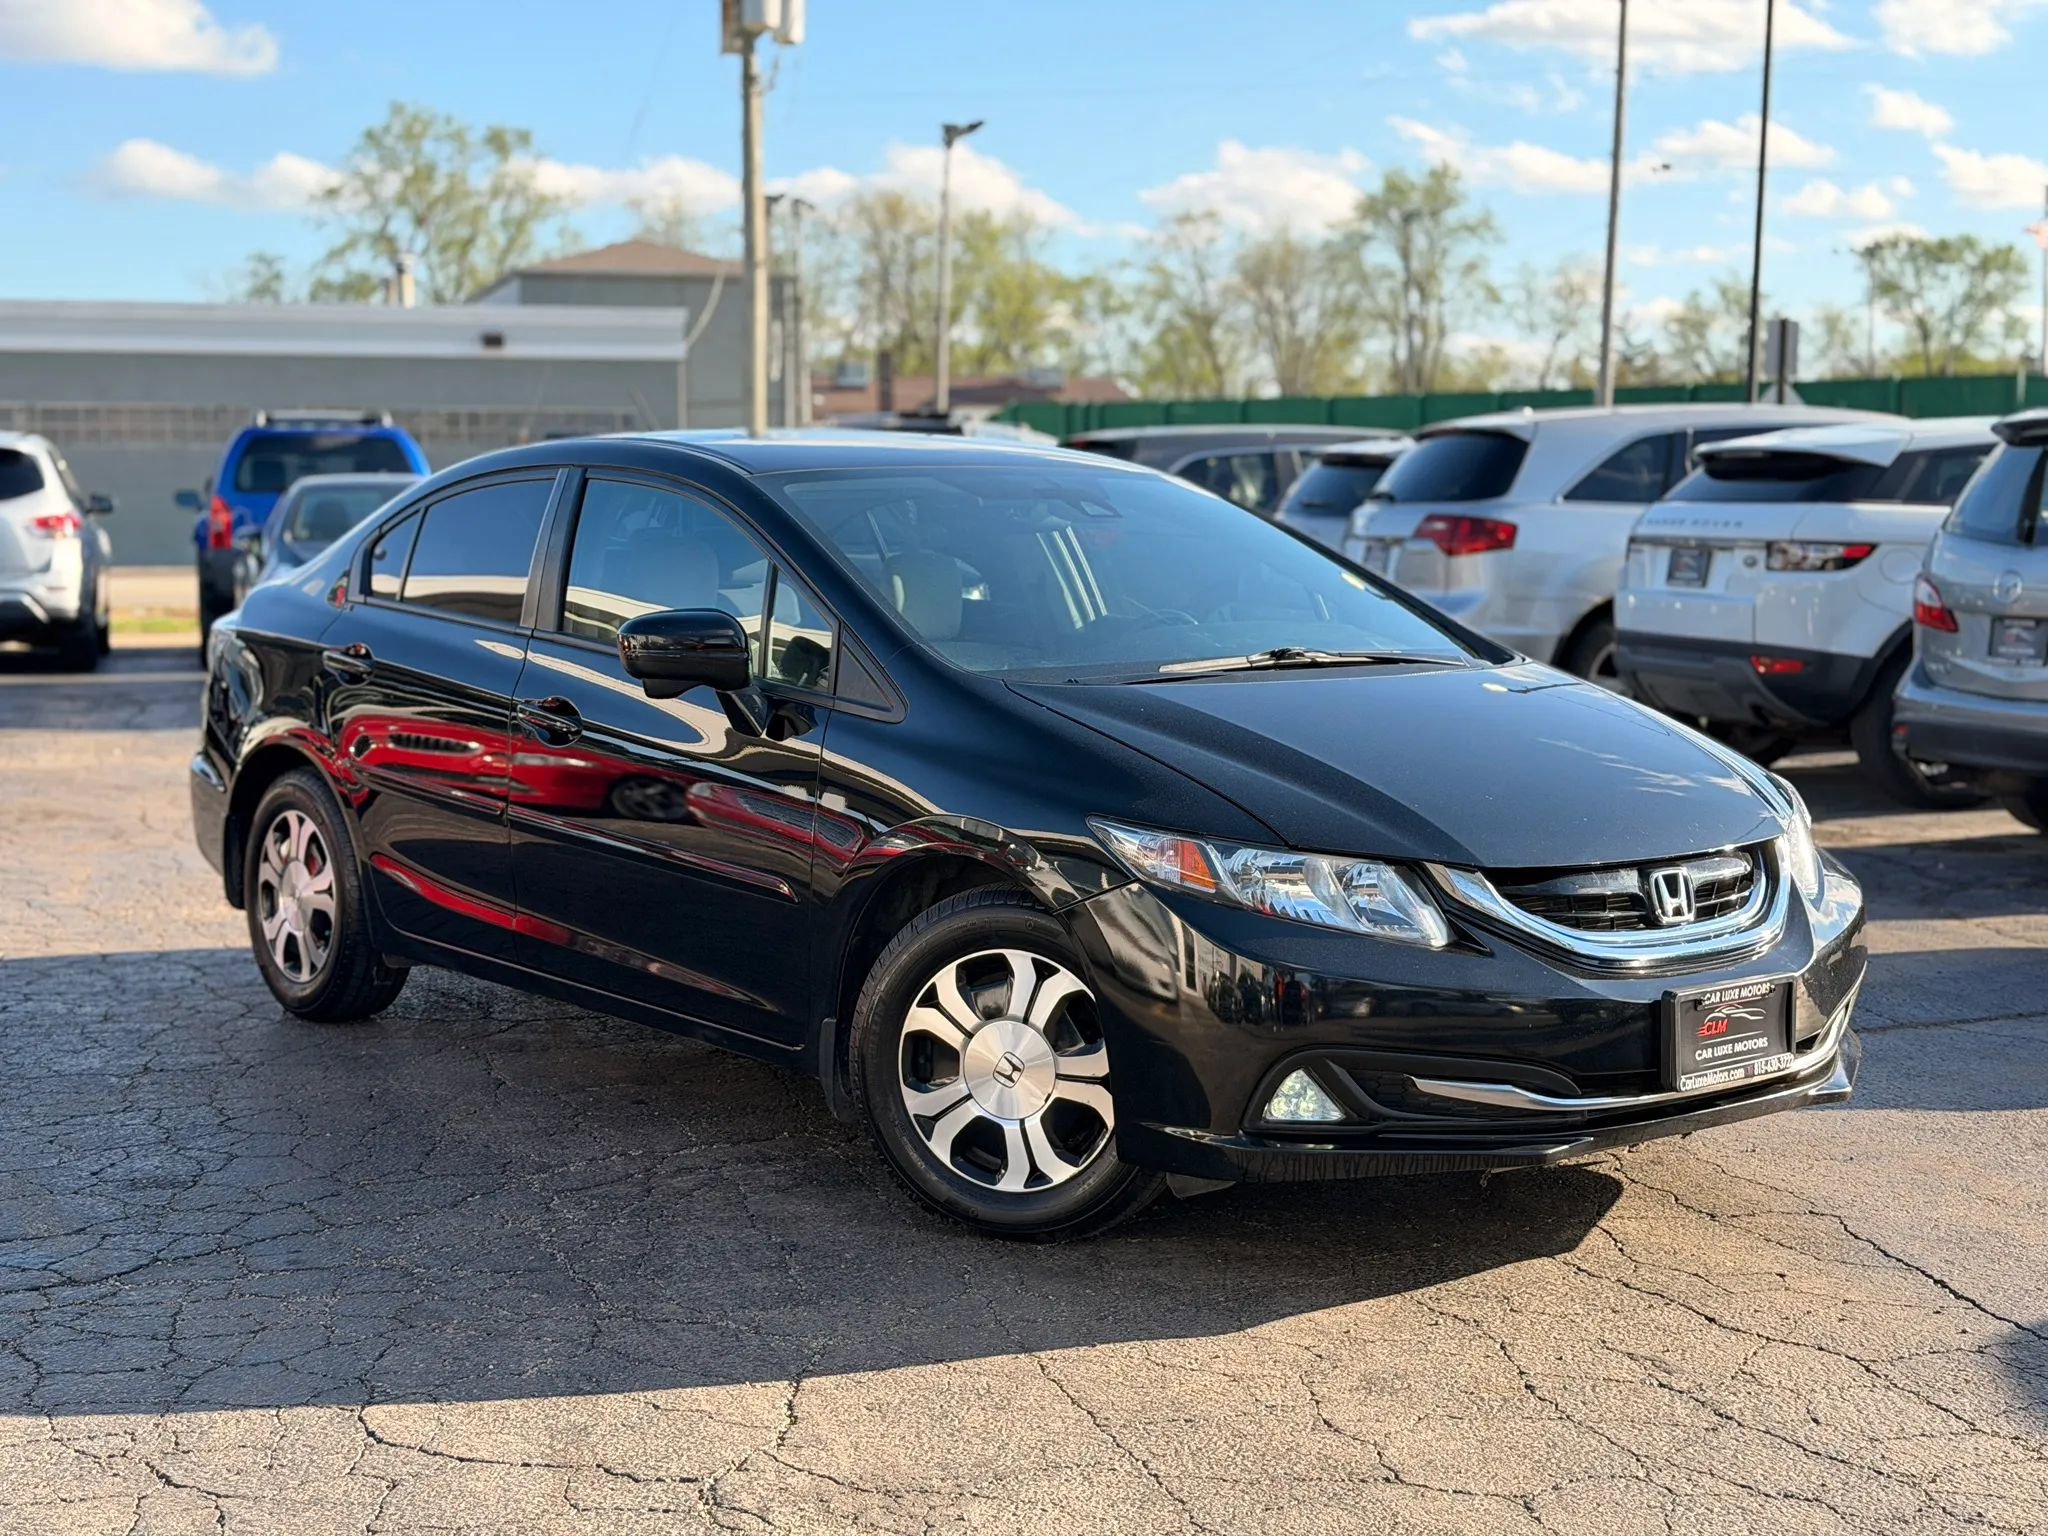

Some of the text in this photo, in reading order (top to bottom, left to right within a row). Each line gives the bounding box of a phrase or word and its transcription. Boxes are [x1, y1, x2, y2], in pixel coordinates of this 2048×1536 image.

[1704, 982, 1771, 1005] CAR LUXE MOTORS
[1703, 1018, 1728, 1036] CLM
[1695, 1037, 1769, 1061] CAR LUXE MOTORS
[1680, 1067, 1745, 1092] CarLuxeMotors.com
